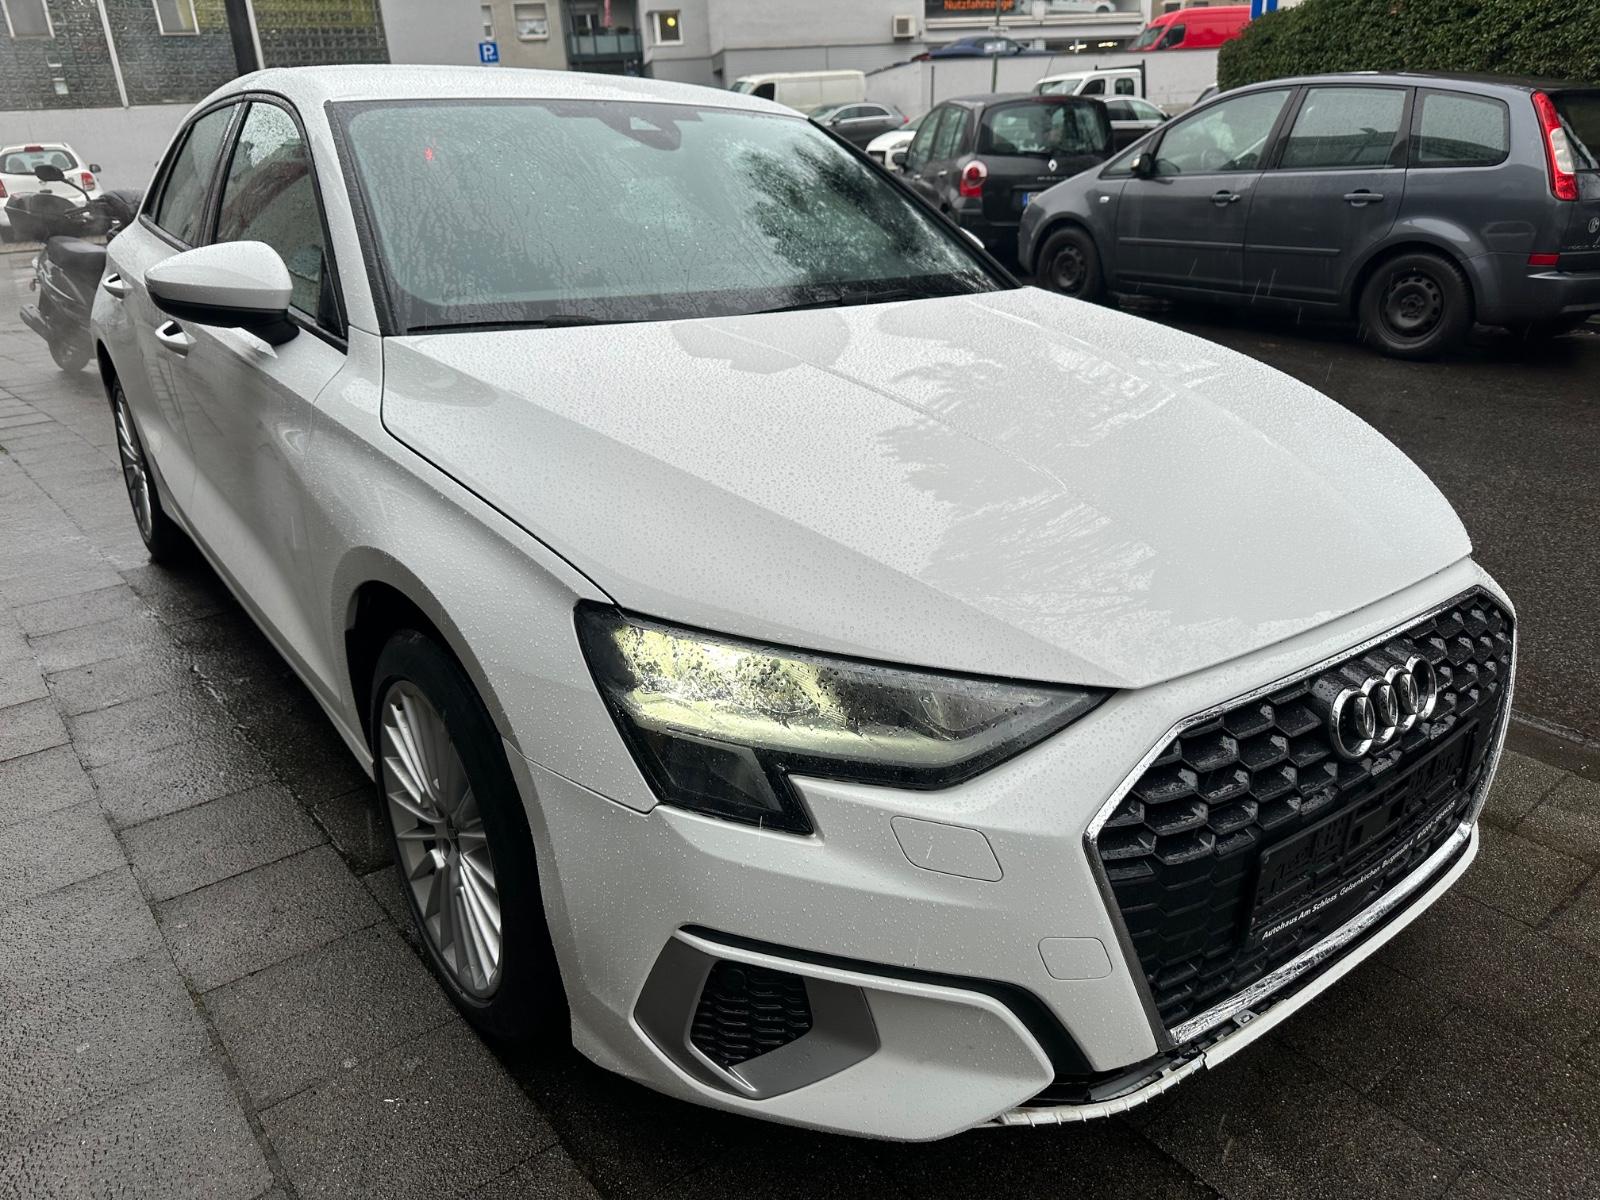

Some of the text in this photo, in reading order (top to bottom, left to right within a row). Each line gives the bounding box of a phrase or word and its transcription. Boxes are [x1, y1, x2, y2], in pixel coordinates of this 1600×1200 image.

[944, 0, 1013, 10] Nutzfahrzege
[482, 44, 494, 61] P
[1262, 916, 1298, 940] Autohaus
[1298, 908, 1311, 920] Am
[1312, 893, 1338, 912] Schloss
